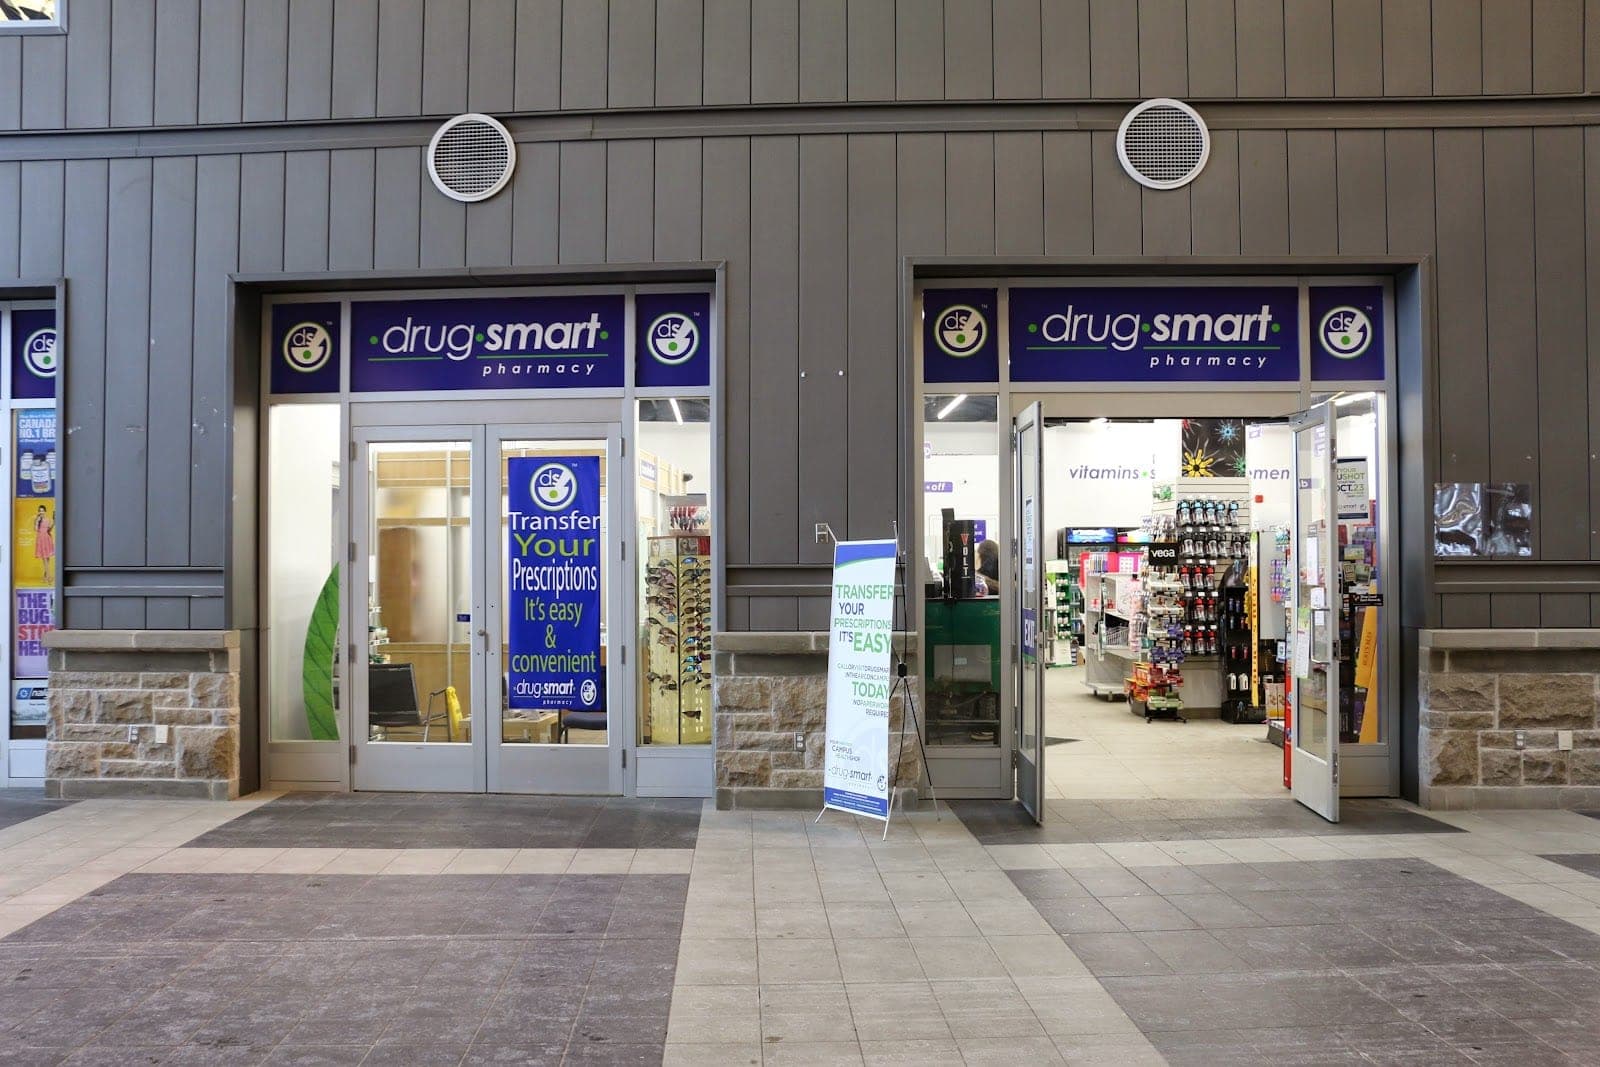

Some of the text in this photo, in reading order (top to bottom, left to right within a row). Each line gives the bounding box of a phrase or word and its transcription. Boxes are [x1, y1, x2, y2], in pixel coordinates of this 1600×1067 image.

[383, 313, 602, 359] drug smart
[1042, 305, 1272, 351] drug smart
[482, 363, 596, 377] pharmacy
[1150, 354, 1267, 368] pharmacy
[1069, 465, 1139, 480] vitamins
[508, 511, 600, 530] Transfer
[514, 533, 595, 557] Your
[513, 558, 598, 599] Prescriptions
[17, 593, 48, 608] THE
[839, 602, 865, 616] YOUR
[18, 609, 50, 625] BUG
[525, 597, 583, 628] It's easy
[546, 624, 557, 649] &
[512, 650, 597, 673] convenient
[517, 679, 574, 698] drug smart
